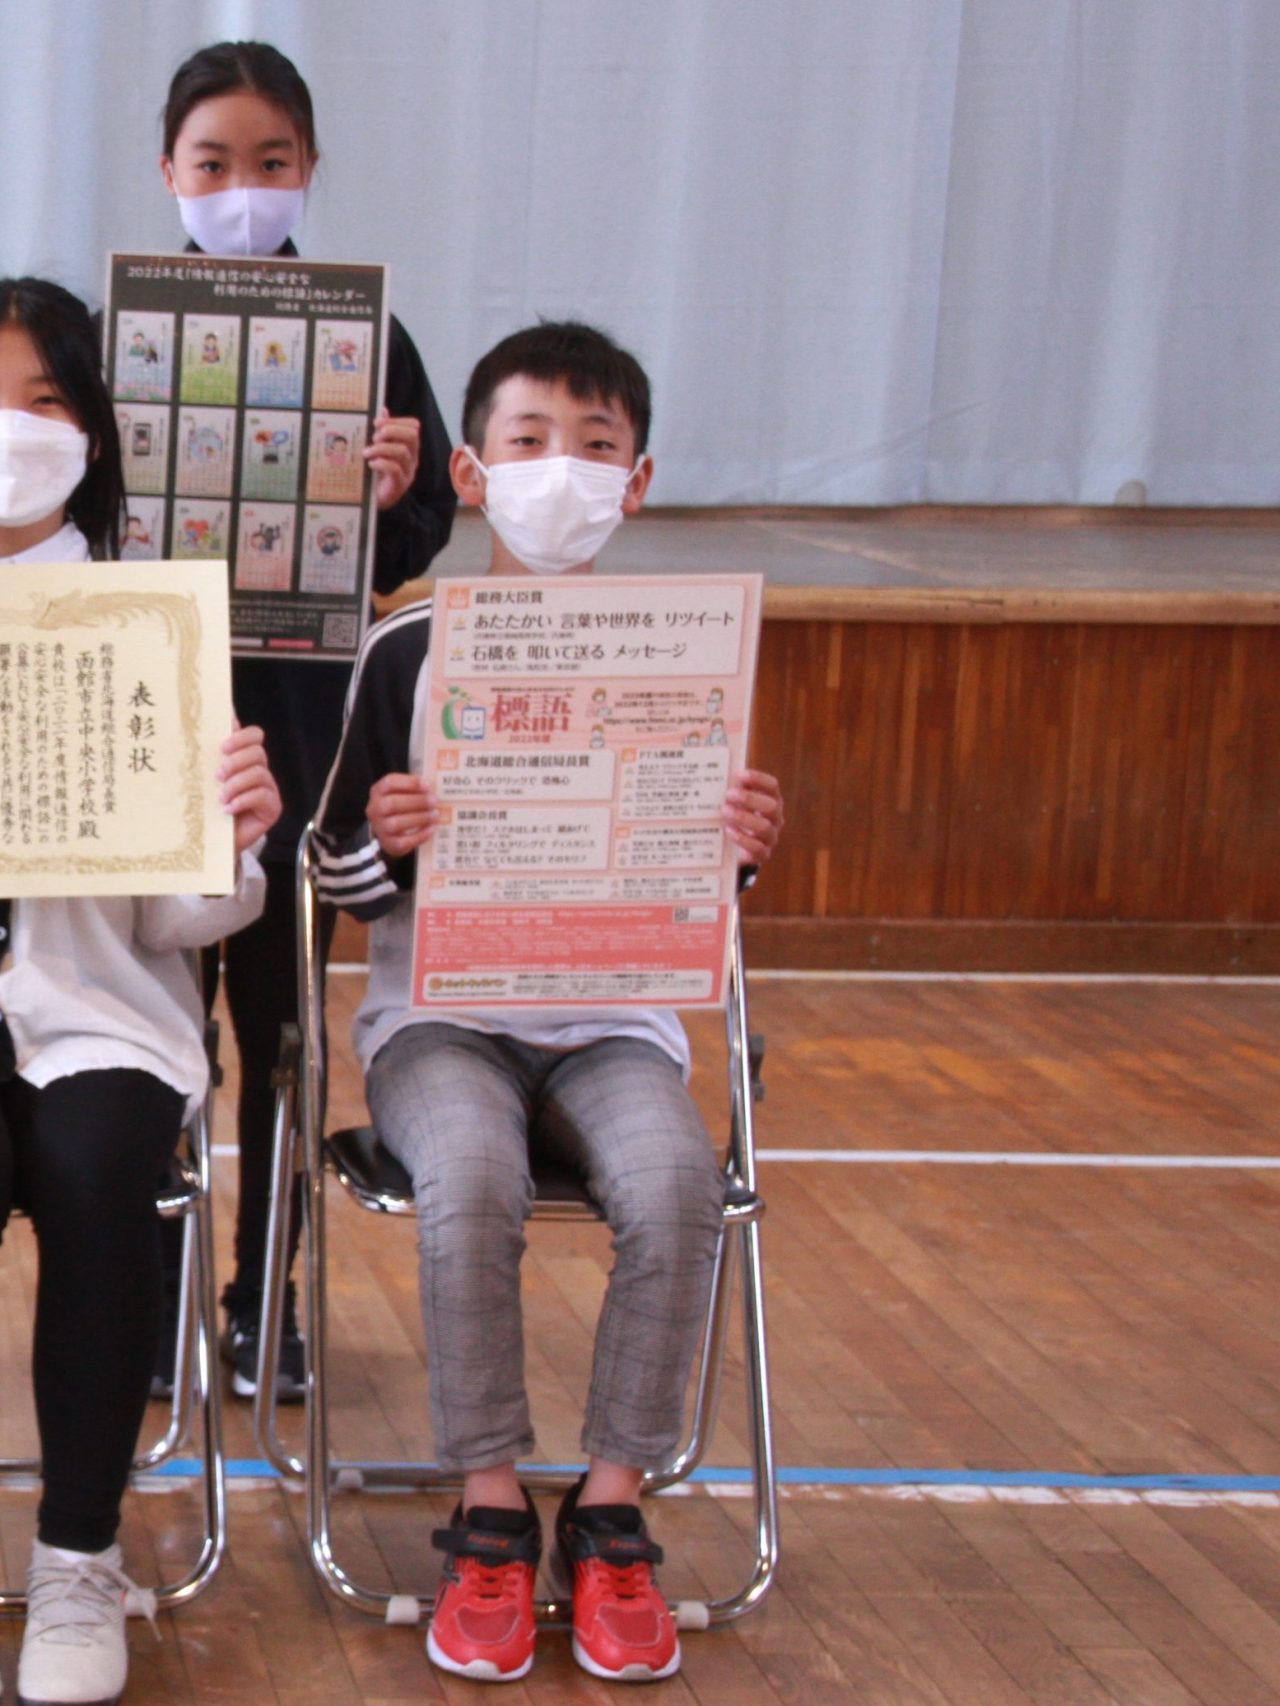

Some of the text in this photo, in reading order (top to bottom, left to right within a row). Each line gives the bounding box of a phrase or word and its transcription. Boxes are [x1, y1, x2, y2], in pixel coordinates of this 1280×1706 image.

[475, 591, 543, 604] 総務大臣賞
[474, 611, 735, 629] あたたかい 言葉や世界を リツイート
[472, 643, 687, 661] 石橋を 叩いて送る メッセージ
[491, 691, 572, 733] 標語
[129, 681, 156, 774] 表彰状
[76, 651, 100, 839] 函館市立中央小学校殿
[465, 755, 591, 768] 北海道総合通信局長賞
